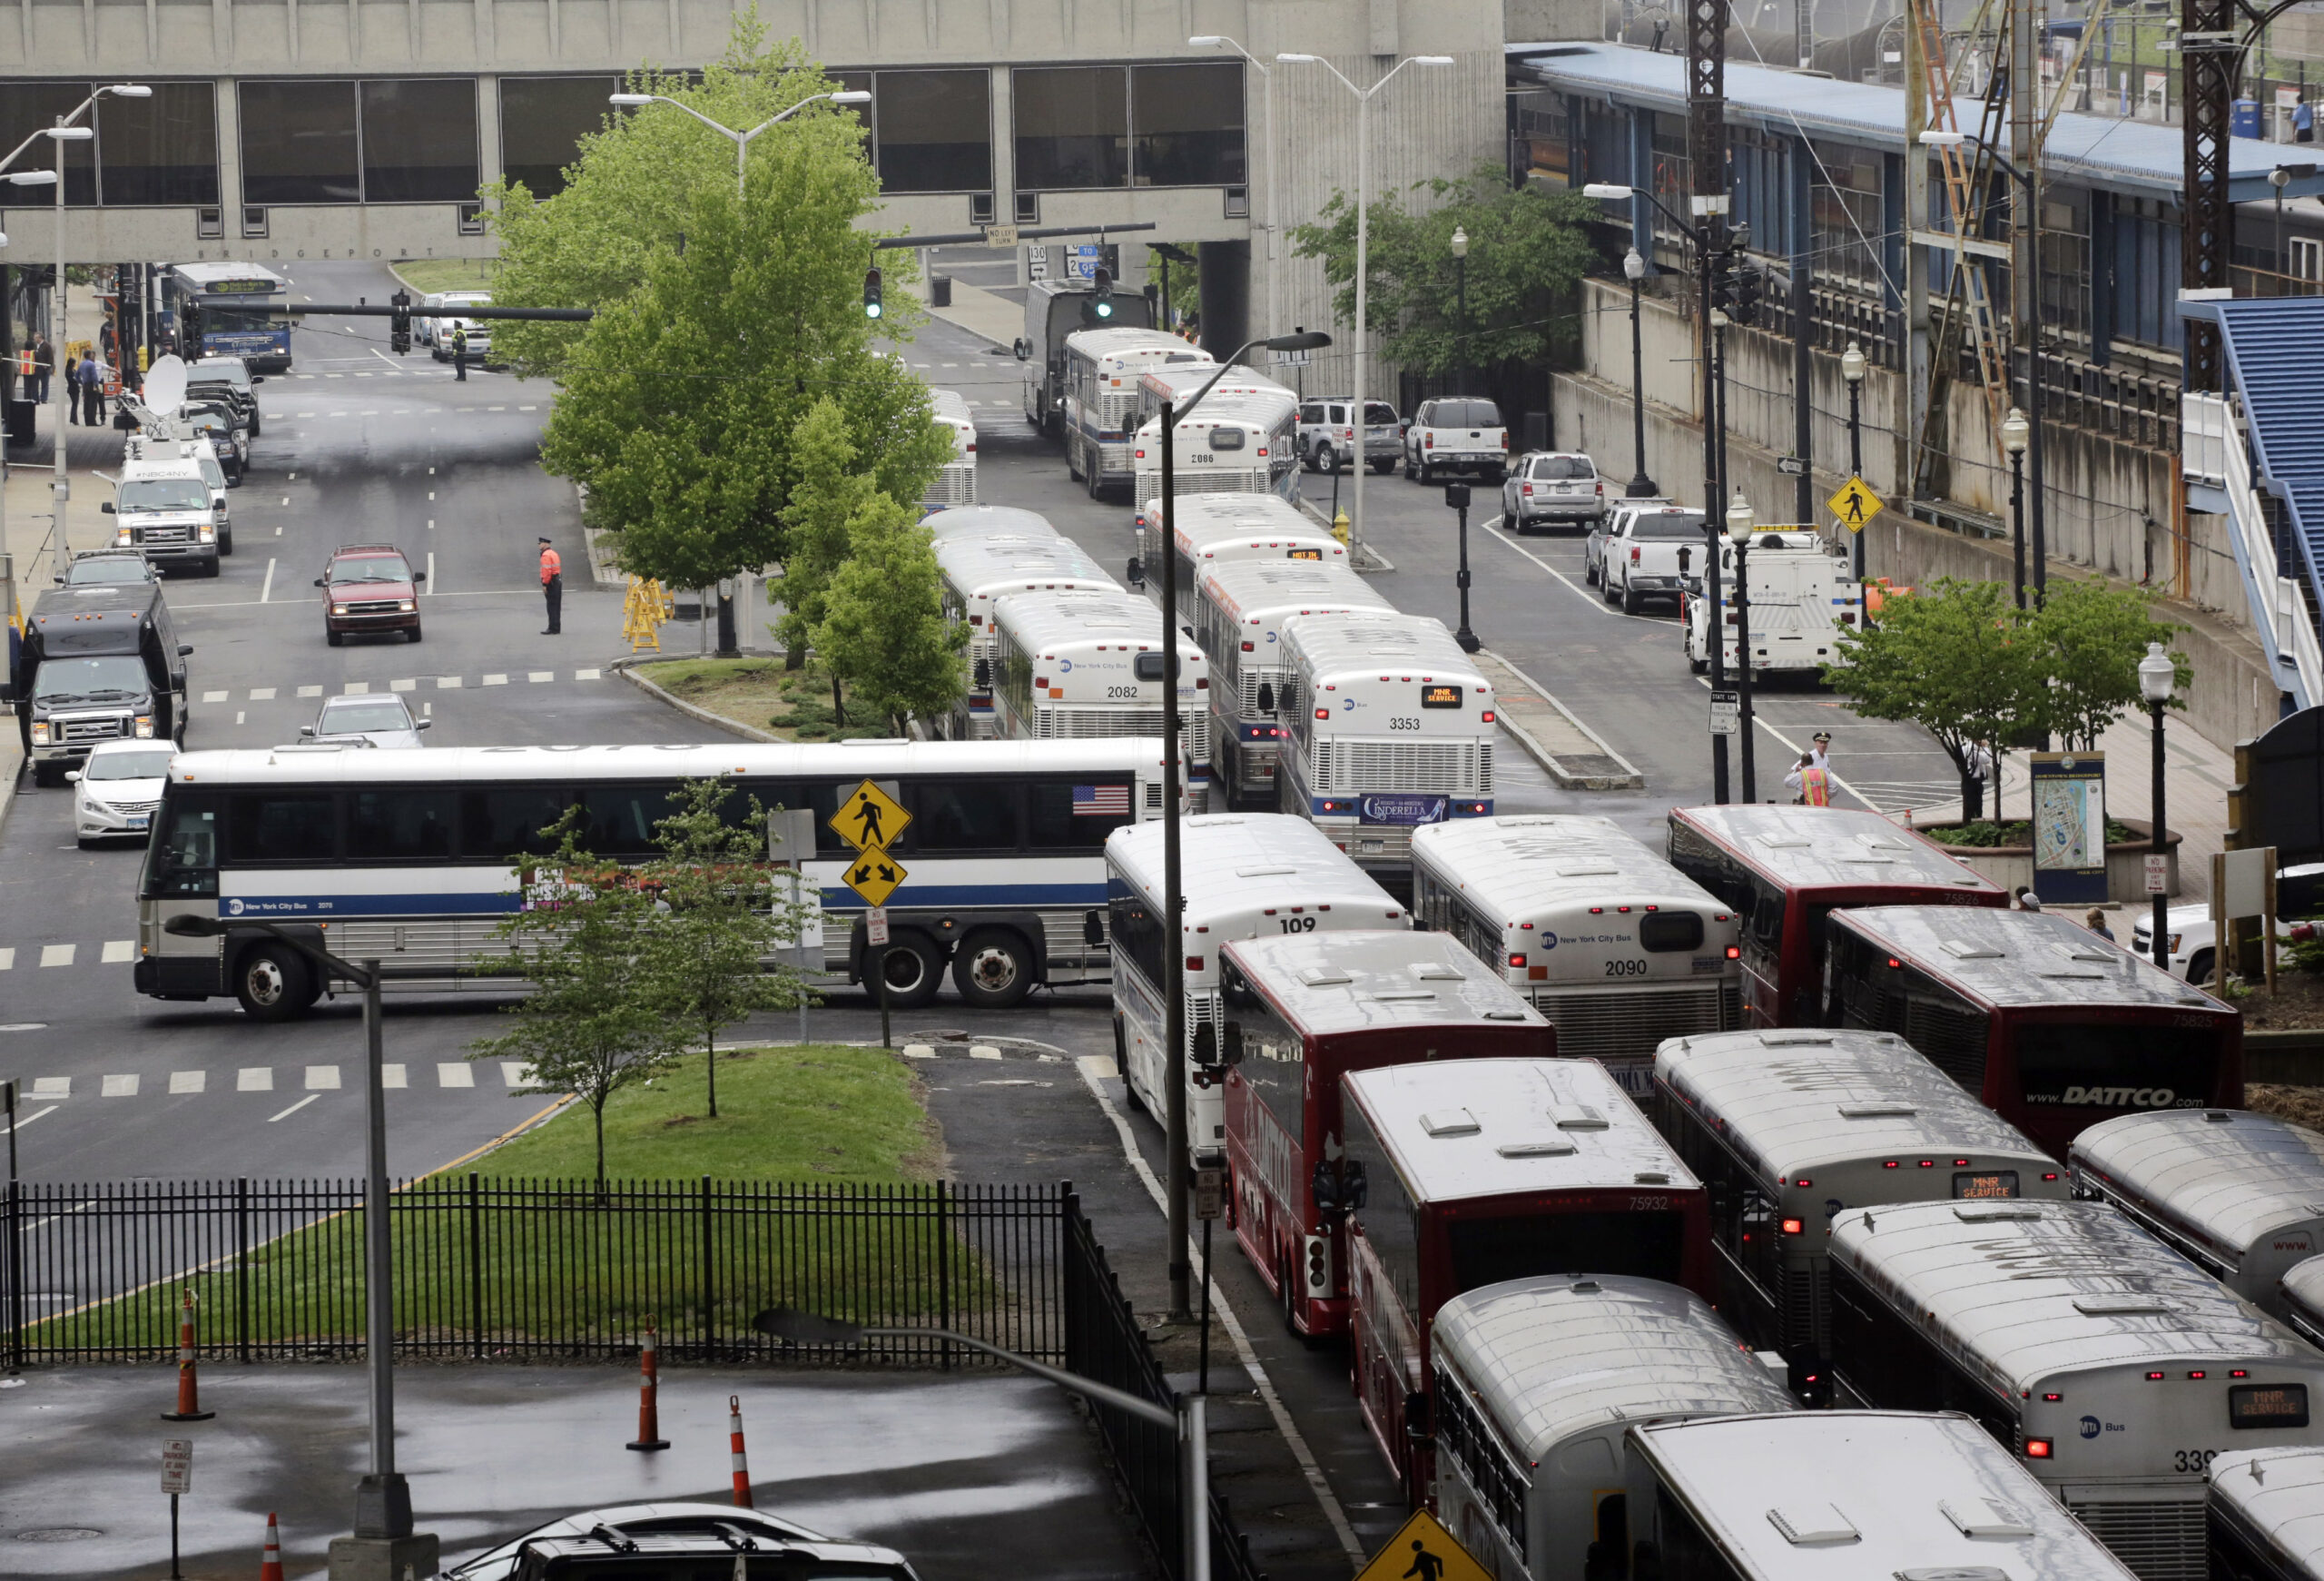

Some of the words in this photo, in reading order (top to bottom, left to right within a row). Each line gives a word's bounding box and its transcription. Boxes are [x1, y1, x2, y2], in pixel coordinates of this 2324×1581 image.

[198, 248, 434, 259] BRIDGEPORT
[1030, 246, 1045, 259] 130
[1082, 264, 1095, 274] 95
[1192, 454, 1214, 463] 2086
[1102, 663, 1115, 671] City
[1108, 687, 1137, 698] 2082
[1389, 717, 1421, 730] 3353
[1945, 893, 1979, 905] 75826
[279, 903, 292, 911] City
[1280, 916, 1316, 934] 109
[1560, 936, 1577, 944] New
[1579, 935, 1596, 944] York
[1598, 934, 1614, 944] City
[1605, 959, 1647, 976] 2090
[2173, 1014, 2212, 1028] 75825
[2026, 1086, 2204, 1108] www.DATTCO.com
[1973, 1177, 2000, 1188] MNR
[1963, 1187, 2010, 1198] SERVICE
[1630, 1196, 1669, 1210] 75932
[2273, 1241, 2311, 1250] www.
[2253, 1391, 2285, 1403] MNR
[2242, 1403, 2297, 1415] SERVICE
[2105, 1422, 2126, 1432] Bus
[172, 1442, 182, 1450] NO
[2174, 1449, 2230, 1473] 339
